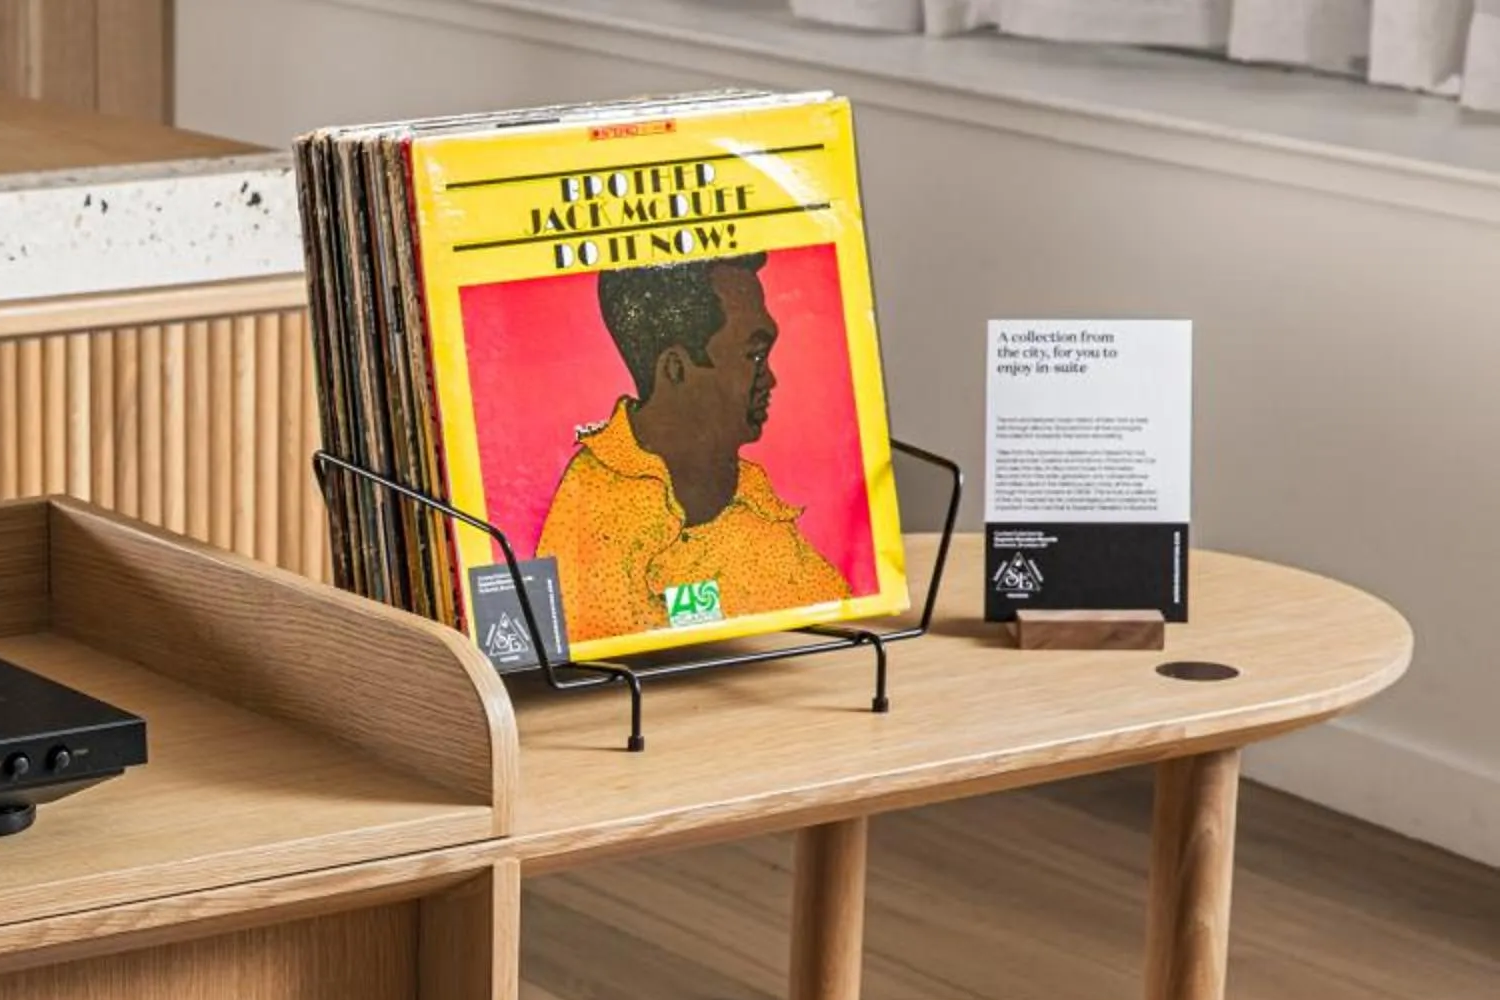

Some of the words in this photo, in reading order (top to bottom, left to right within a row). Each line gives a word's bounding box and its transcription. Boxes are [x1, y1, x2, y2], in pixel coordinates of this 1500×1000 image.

[560, 162, 716, 203] BROTHER
[522, 197, 612, 236] JACK
[553, 239, 599, 270] DO
[607, 232, 640, 263] IT
[649, 222, 738, 258] NOW!
[998, 331, 1009, 343] A
[1011, 330, 1077, 343] collection
[1080, 330, 1115, 343] from
[997, 346, 1020, 358] the
[1022, 346, 1051, 361] city,
[1053, 345, 1073, 358] for
[1074, 348, 1100, 361] you
[1102, 347, 1118, 358] to
[997, 362, 1031, 377] enjoy
